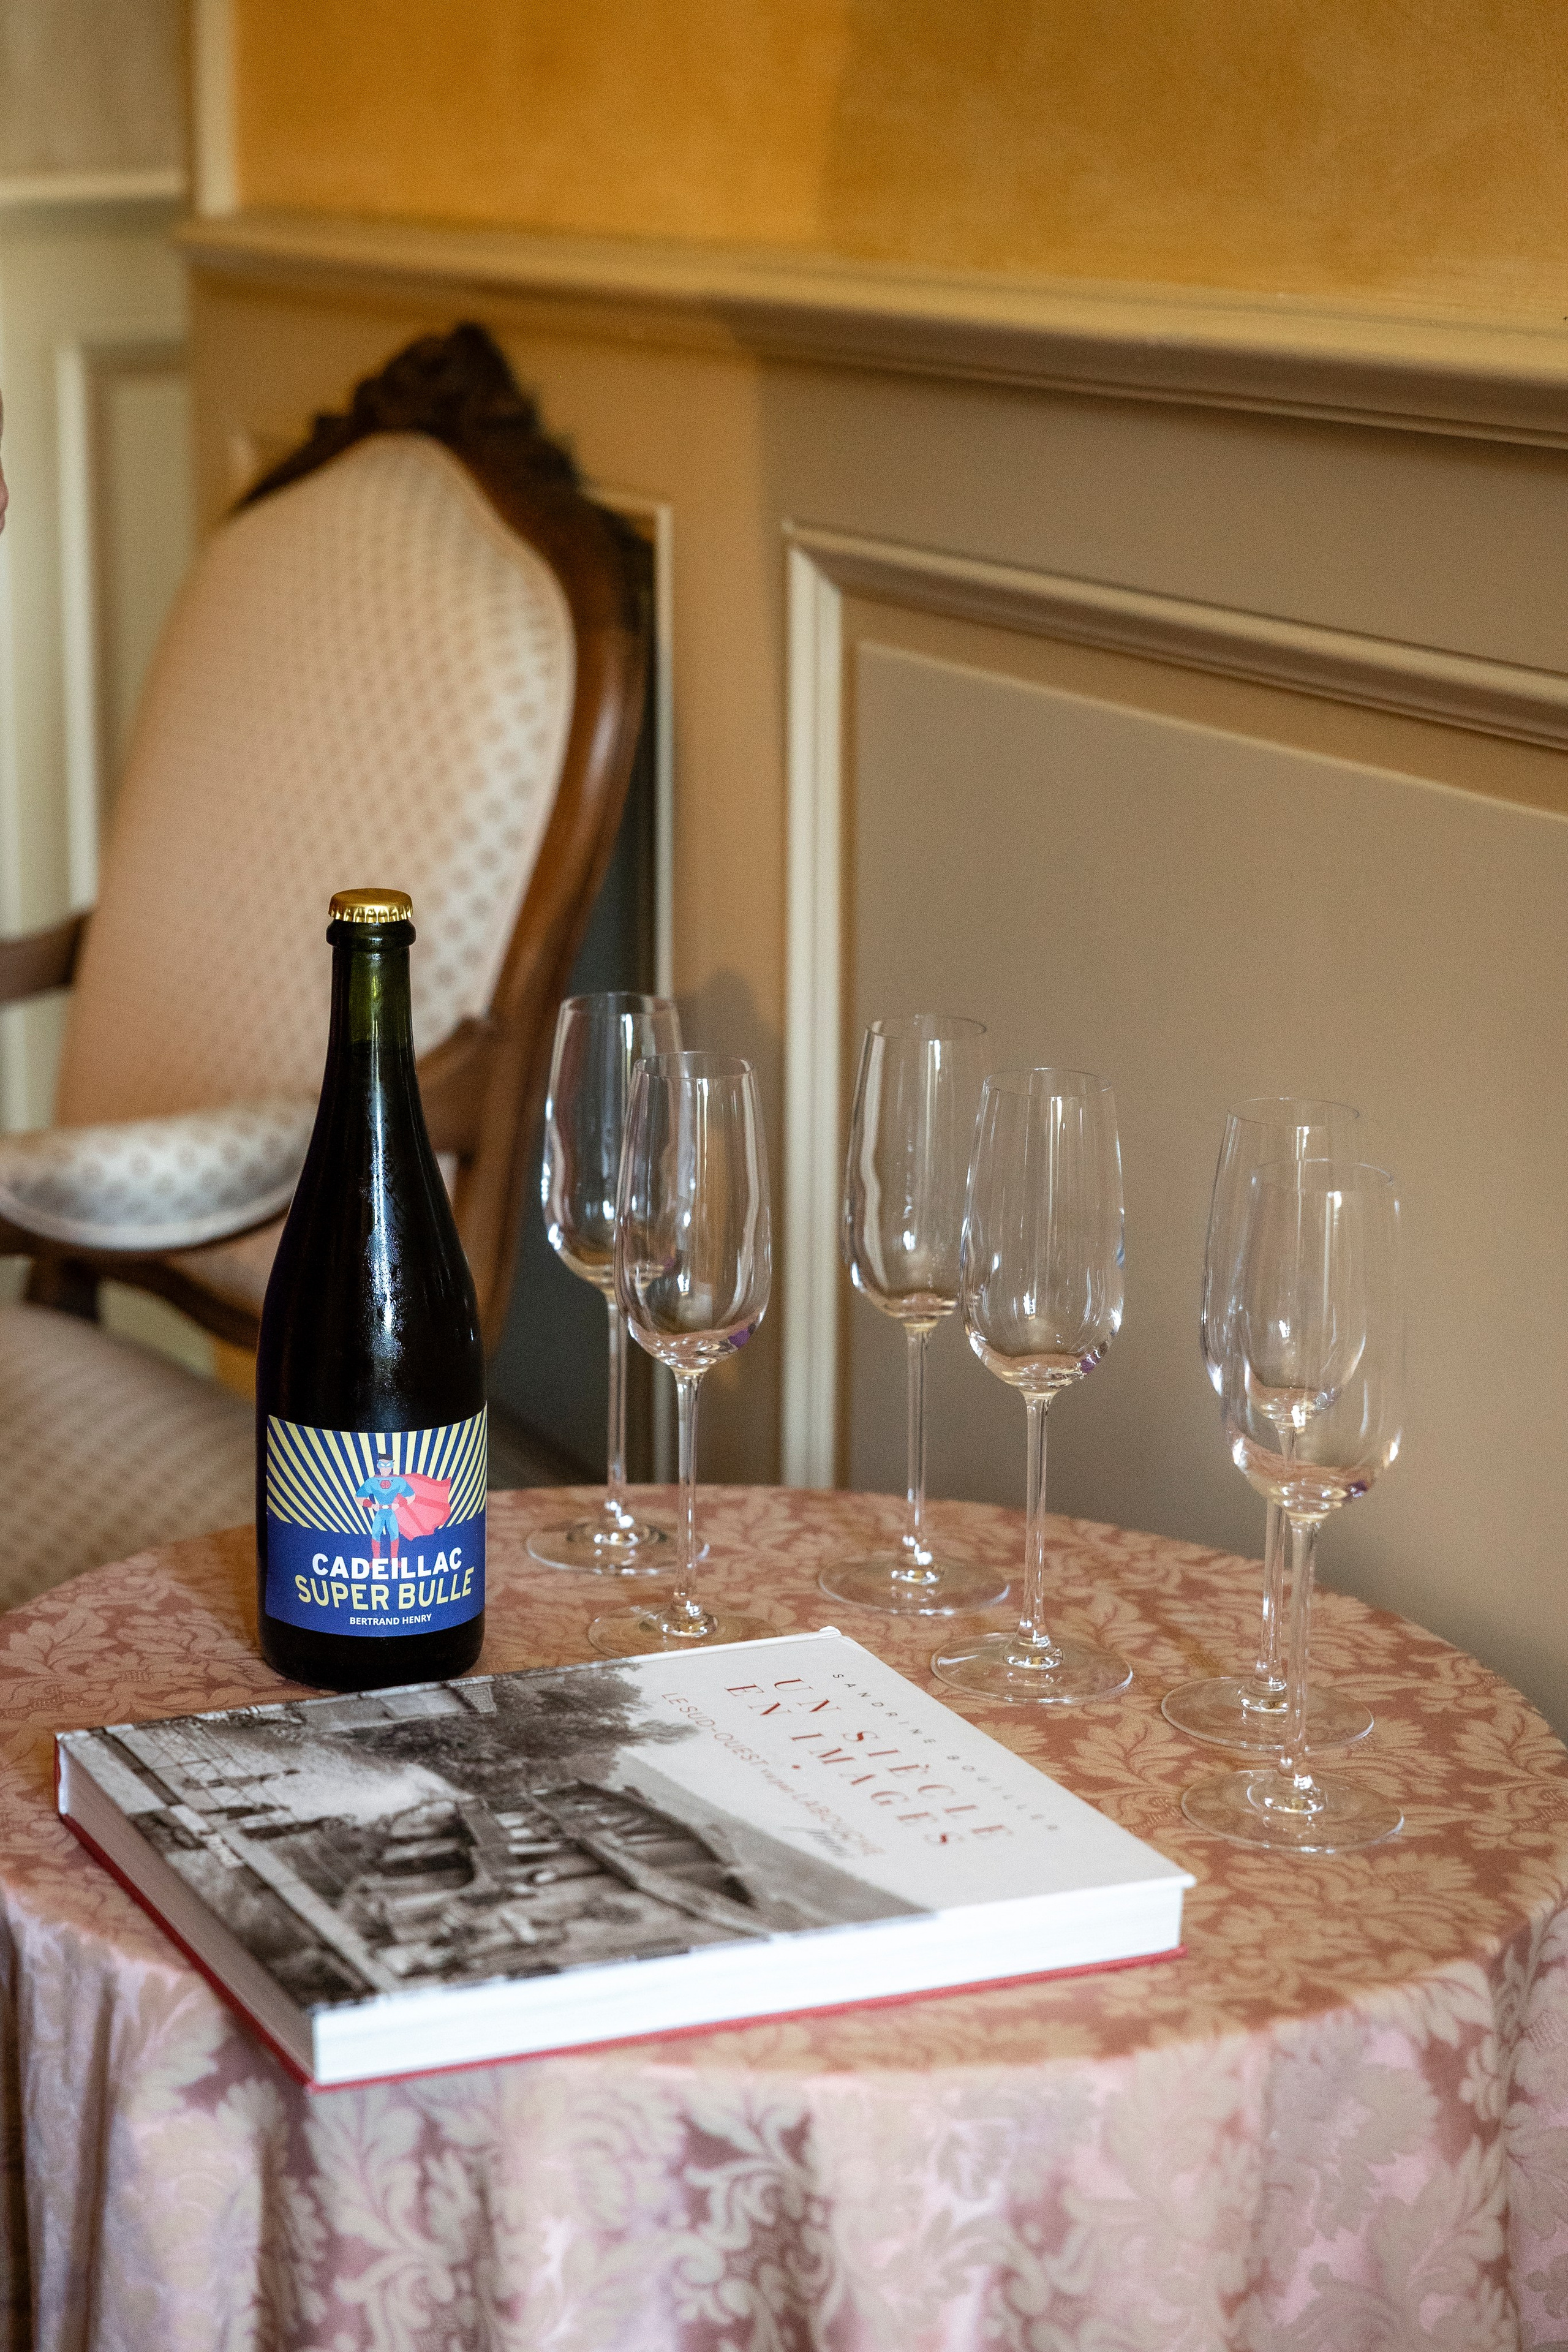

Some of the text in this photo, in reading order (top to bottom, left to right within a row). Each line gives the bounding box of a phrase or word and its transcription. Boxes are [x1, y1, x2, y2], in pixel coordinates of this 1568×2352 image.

[312, 1547, 462, 1580] CADEILLAC
[295, 1566, 475, 1610] SUPER BULLE
[350, 1613, 432, 1626] BERTRAND HENRY
[662, 1692, 689, 1705] LE
[774, 1677, 842, 1713] UN
[724, 1684, 793, 1716] EN
[788, 1731, 966, 1845] IMAGES
